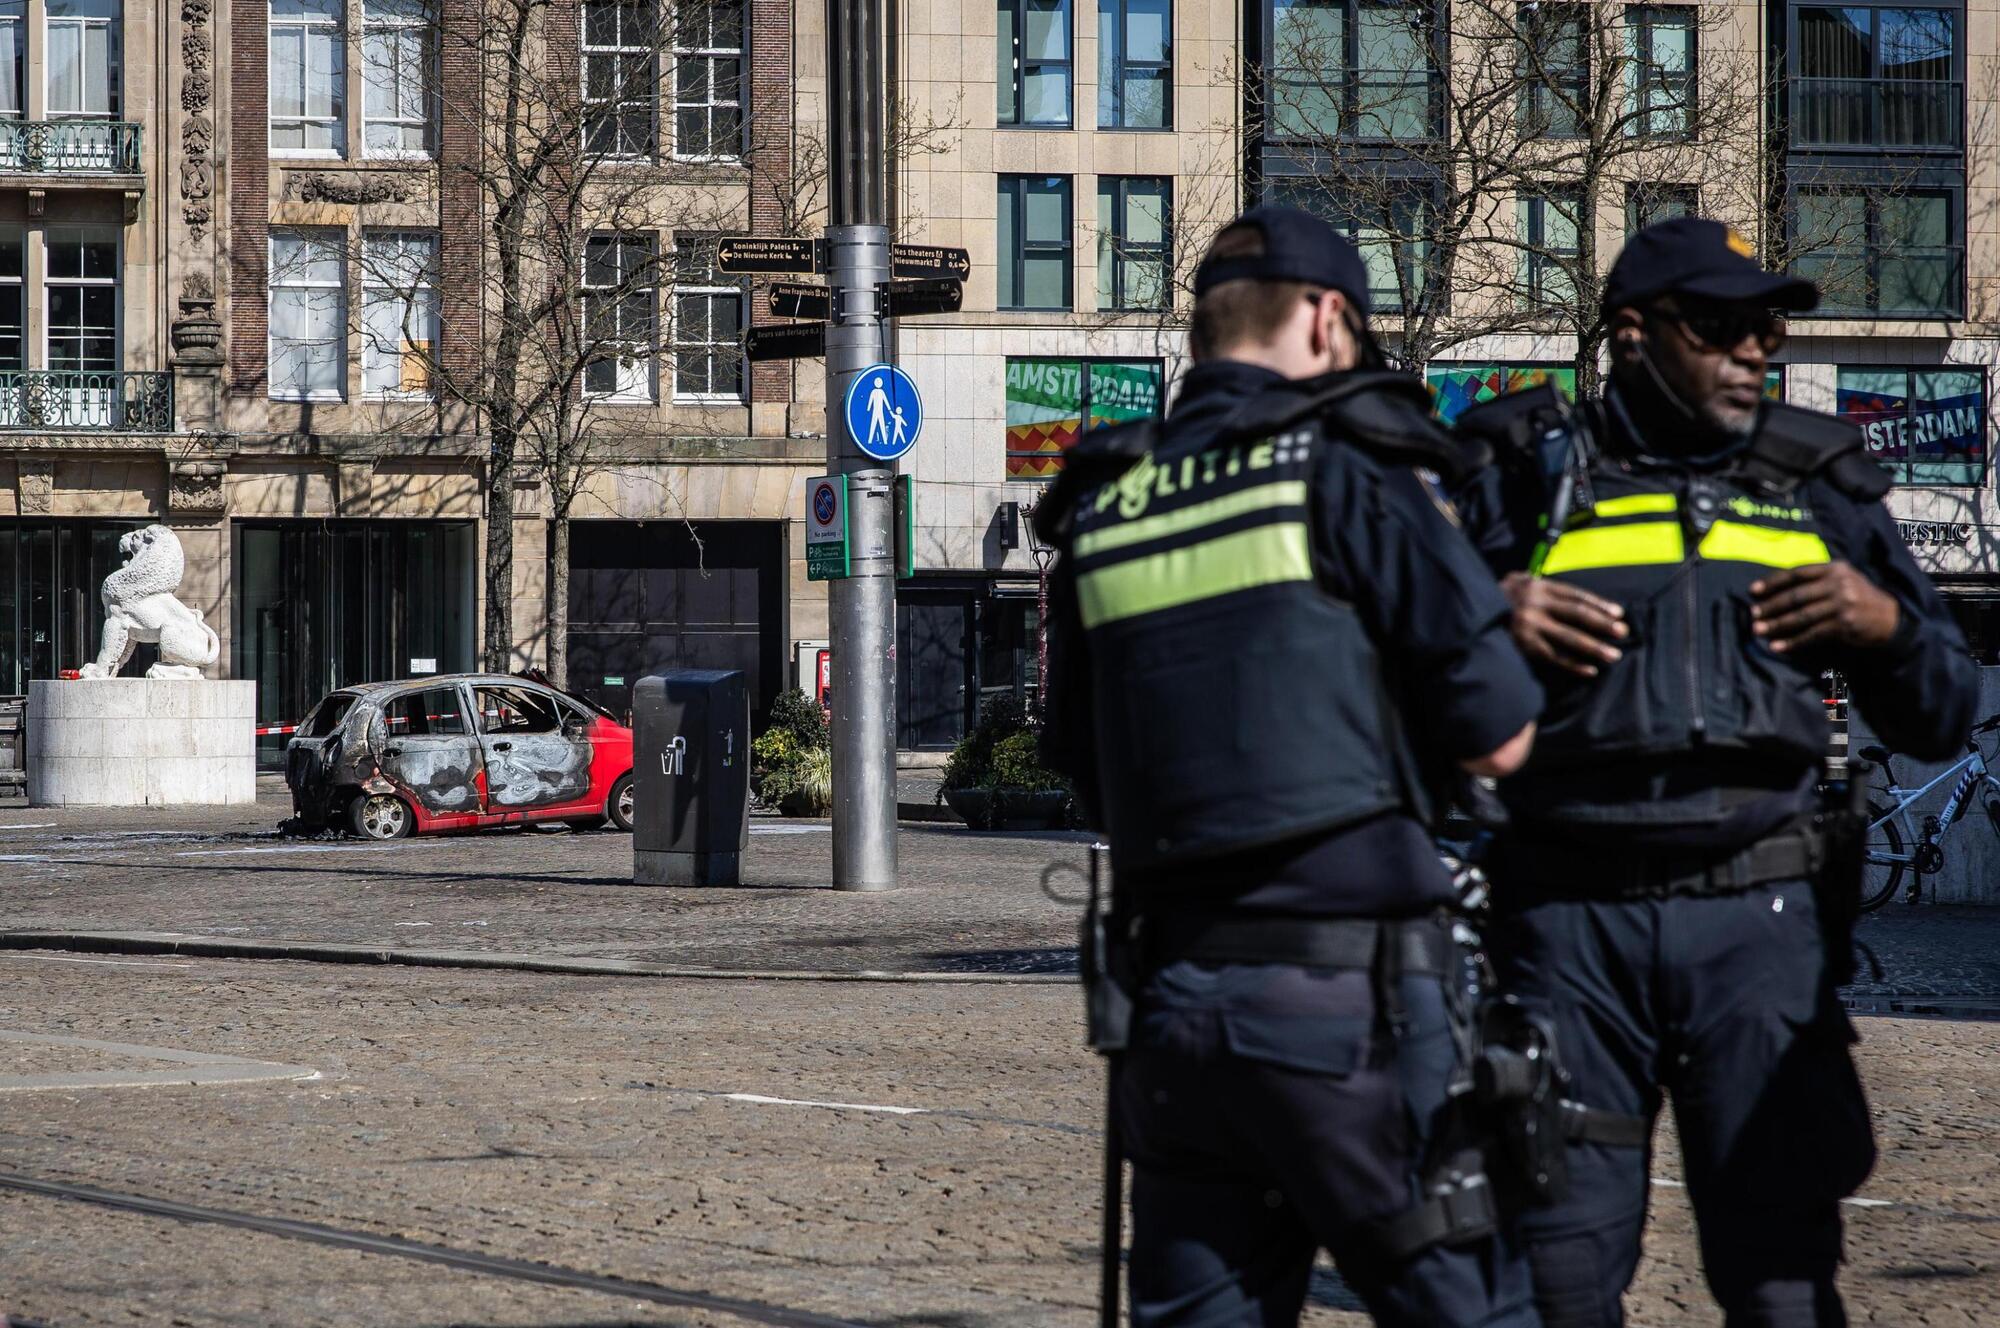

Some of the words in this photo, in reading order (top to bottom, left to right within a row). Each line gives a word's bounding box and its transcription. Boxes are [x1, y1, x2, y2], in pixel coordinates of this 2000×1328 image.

[733, 243, 768, 251] Koninklijk
[895, 248, 906, 256] Nes
[908, 250, 935, 258] theaters
[895, 257, 933, 265] Nieuwmarkt
[1006, 360, 1156, 414] AMSTERDAM
